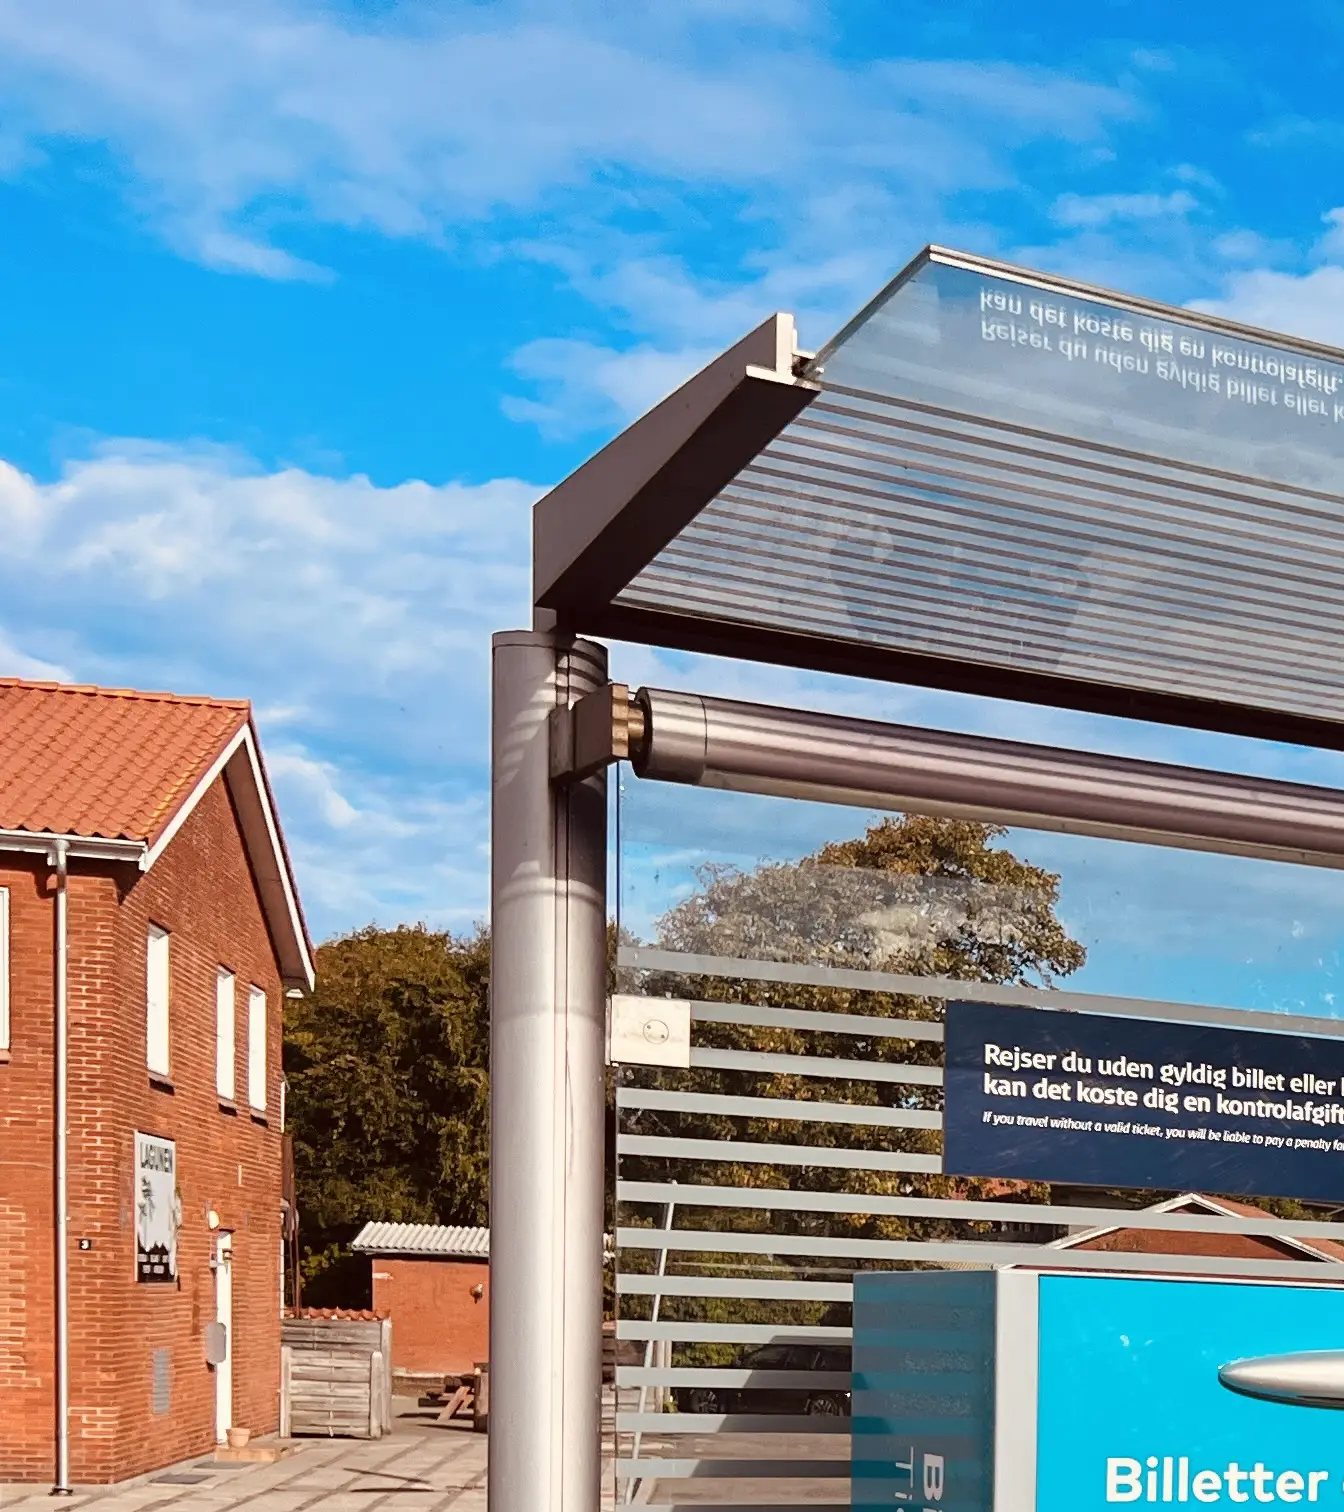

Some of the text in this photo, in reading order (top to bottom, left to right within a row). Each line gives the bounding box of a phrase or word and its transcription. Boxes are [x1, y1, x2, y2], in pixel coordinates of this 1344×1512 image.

[984, 1043, 1057, 1072] Rejser
[1062, 1050, 1091, 1072] du
[1098, 1055, 1153, 1079] uden
[1160, 1063, 1226, 1091] gyldig
[1232, 1069, 1284, 1092] billet
[1290, 1073, 1335, 1097] eller
[983, 1073, 1027, 1098] kan
[1032, 1078, 1071, 1102] det
[1077, 1082, 1138, 1106] koste
[1143, 1088, 1178, 1115] dig
[1184, 1096, 1211, 1112] en
[983, 1111, 992, 1123] If
[992, 1114, 1015, 1127] you
[1016, 1115, 1049, 1128] travel
[1050, 1117, 1093, 1132] without
[1094, 1122, 1102, 1131] a
[1104, 1120, 1130, 1134] valid
[1165, 1128, 1186, 1140] you
[1187, 1127, 1206, 1140] will
[1208, 1129, 1221, 1141] be
[1223, 1130, 1250, 1144] liable
[1252, 1134, 1263, 1145] to
[1265, 1136, 1284, 1148] pay
[1286, 1138, 1293, 1147] a
[1294, 1138, 1332, 1152] penalty
[1106, 1455, 1329, 1503] Billetter
